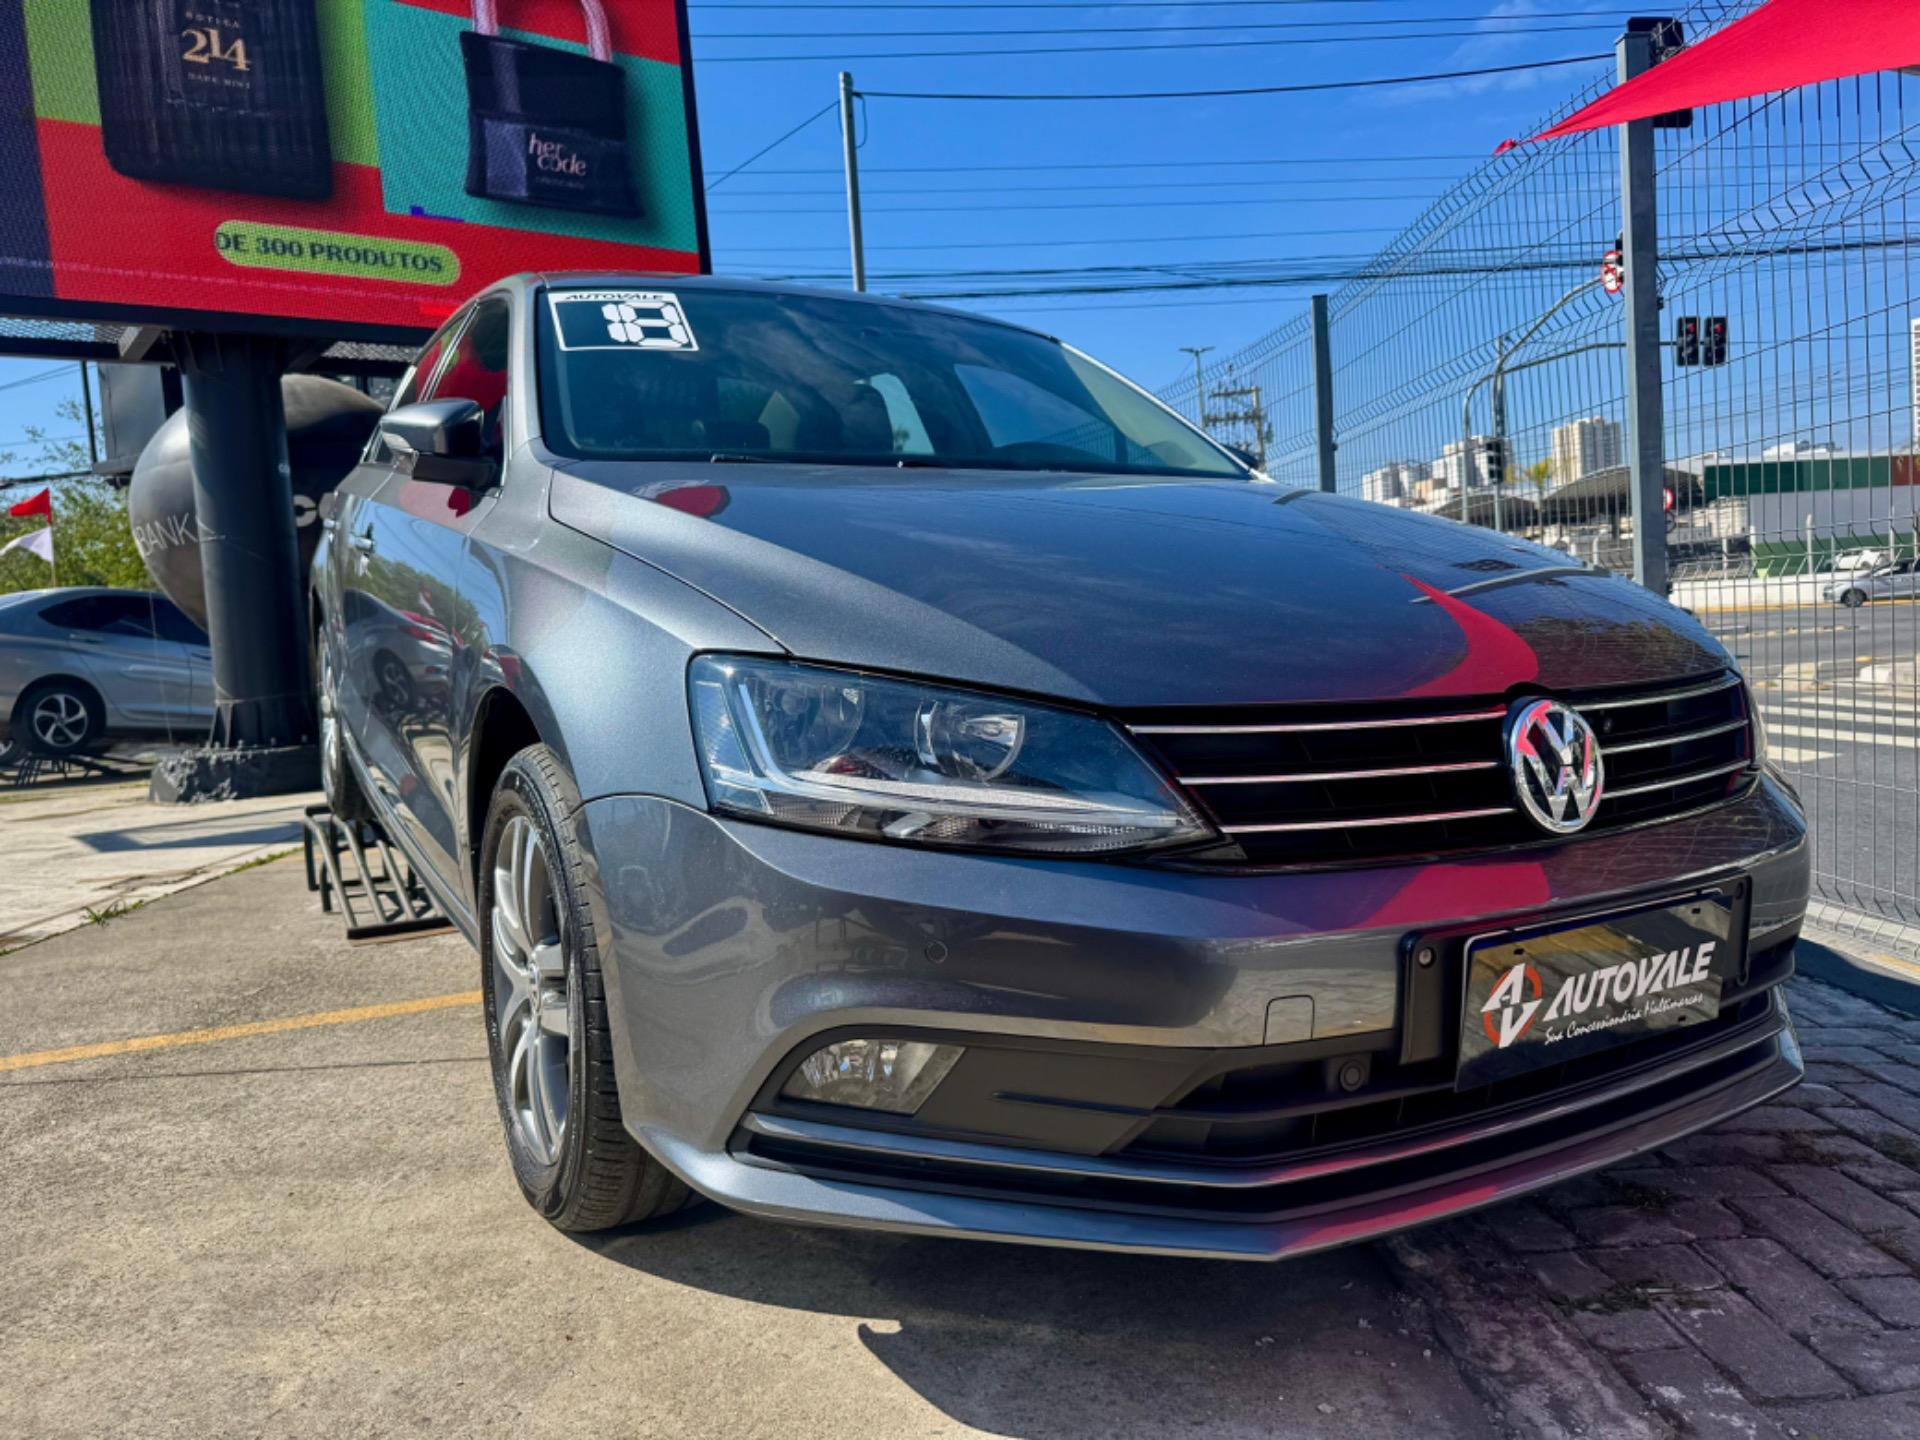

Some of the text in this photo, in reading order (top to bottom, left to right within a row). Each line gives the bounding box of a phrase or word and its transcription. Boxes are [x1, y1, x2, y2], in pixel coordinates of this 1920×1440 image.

[182, 27, 251, 71] 214
[529, 132, 566, 158] her
[537, 153, 586, 176] code
[215, 232, 443, 273] DE 300 PRODUTOS
[565, 292, 664, 300] AUTOVALE
[601, 301, 689, 348] 18
[134, 511, 199, 557] BANK
[1542, 941, 1716, 1022] AUTOVALE
[1544, 1026, 1564, 1046] Sua
